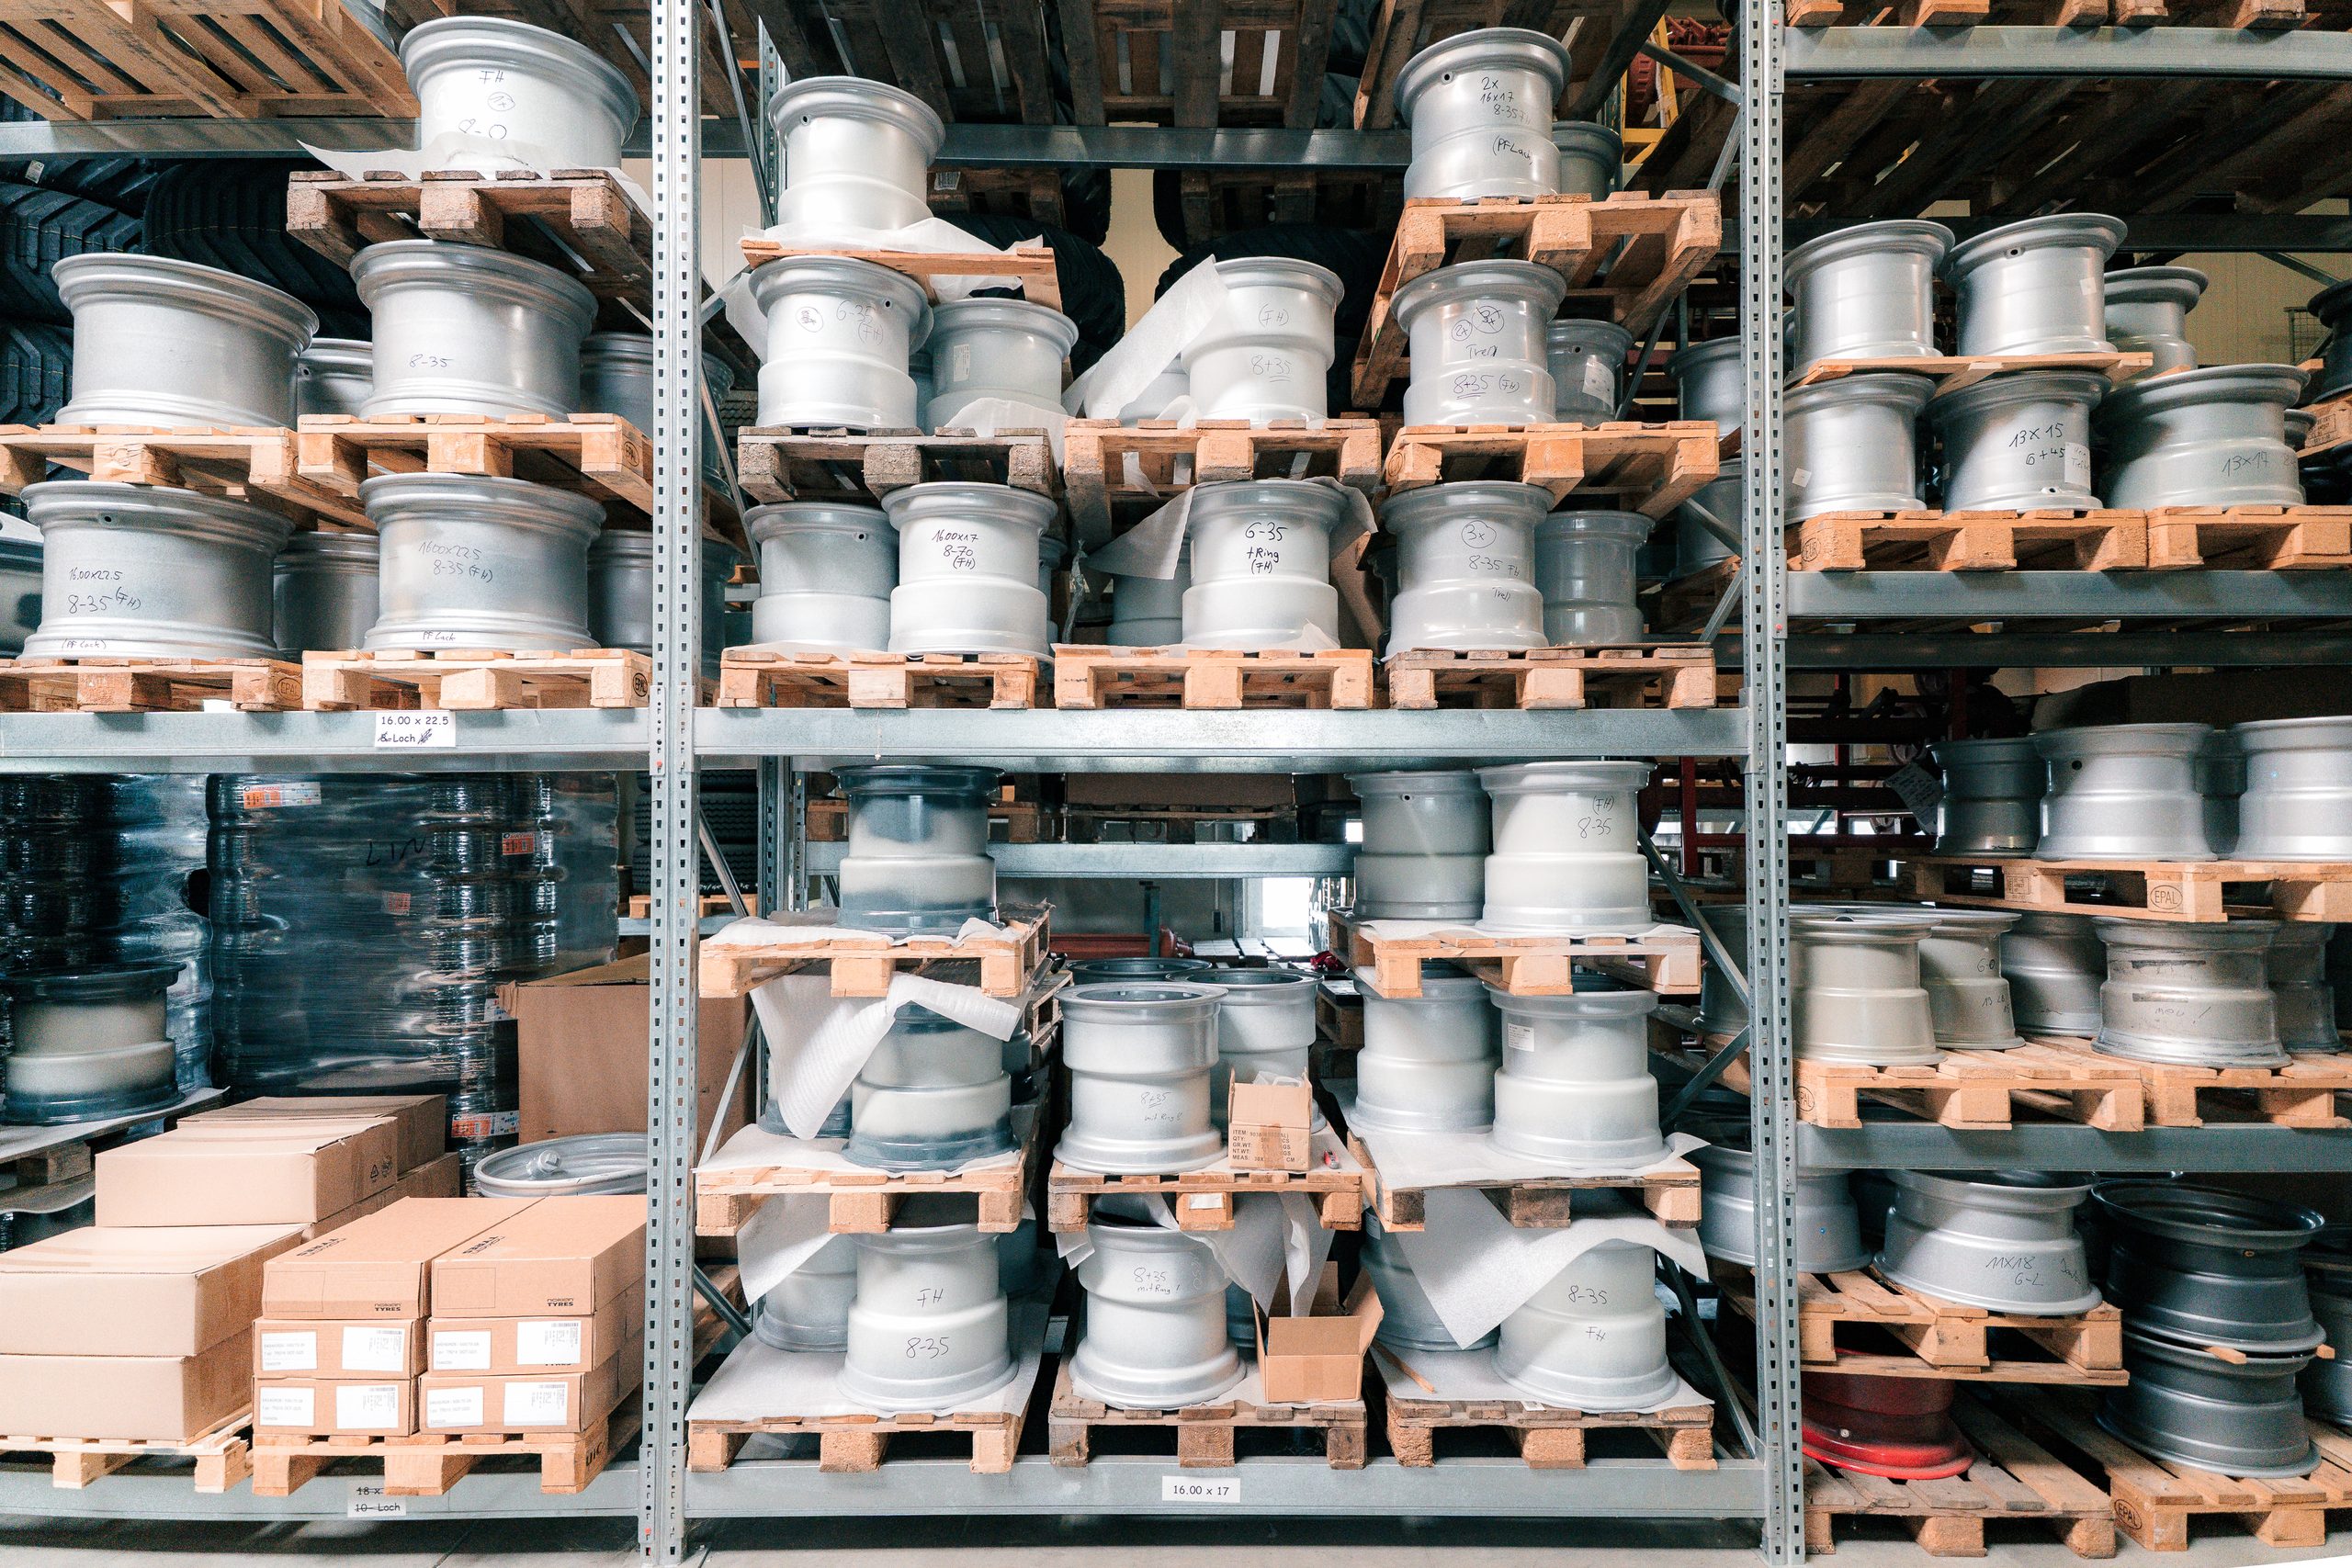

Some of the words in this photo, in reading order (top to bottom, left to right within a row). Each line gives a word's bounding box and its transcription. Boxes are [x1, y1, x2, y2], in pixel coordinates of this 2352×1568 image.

[1481, 76, 1498, 90] 2x
[1480, 92, 1514, 104] 16x17
[410, 354, 454, 367] 8-35
[1465, 525, 1485, 540] 3x
[944, 544, 974, 557] 8-70
[434, 559, 464, 575] 8-35
[953, 556, 976, 570] (FH)
[1469, 555, 1503, 570] 8-35
[68, 594, 112, 615] 8-35
[381, 716, 411, 725] 16.00
[425, 716, 449, 725] 22.5
[1578, 817, 1612, 839] 8-35
[2154, 890, 2178, 905] EPAL
[1568, 1285, 1607, 1304] 8-35
[906, 1337, 949, 1359] 8-35
[1174, 1484, 1202, 1495] 16.00
[1217, 1486, 1229, 1495] 17
[2118, 1502, 2138, 1528] EPAL
